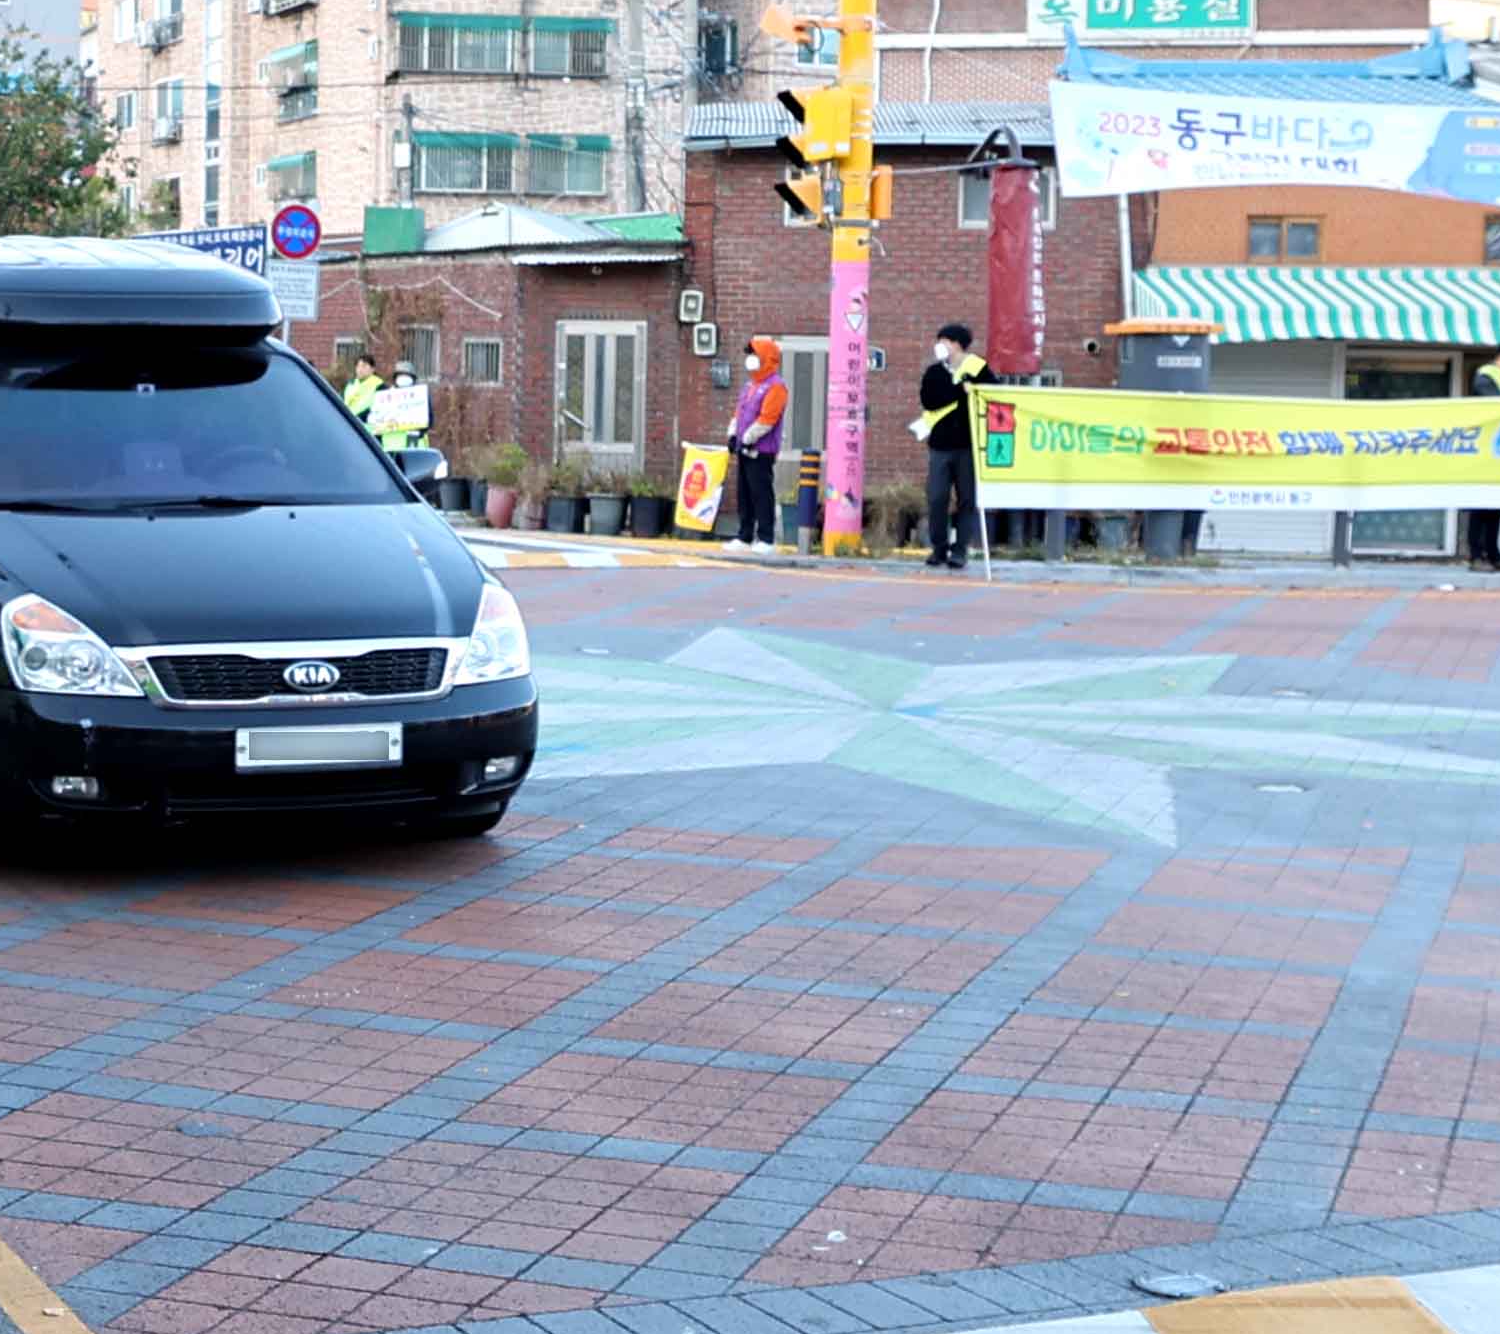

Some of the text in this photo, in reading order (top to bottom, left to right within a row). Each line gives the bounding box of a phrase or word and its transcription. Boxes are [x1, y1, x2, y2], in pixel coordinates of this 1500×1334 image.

[1099, 107, 1328, 152] 2023 동구바다
[1030, 419, 1482, 458] 아이들의 교통안전 함께 지켜주세요
[294, 666, 331, 684] KIA
